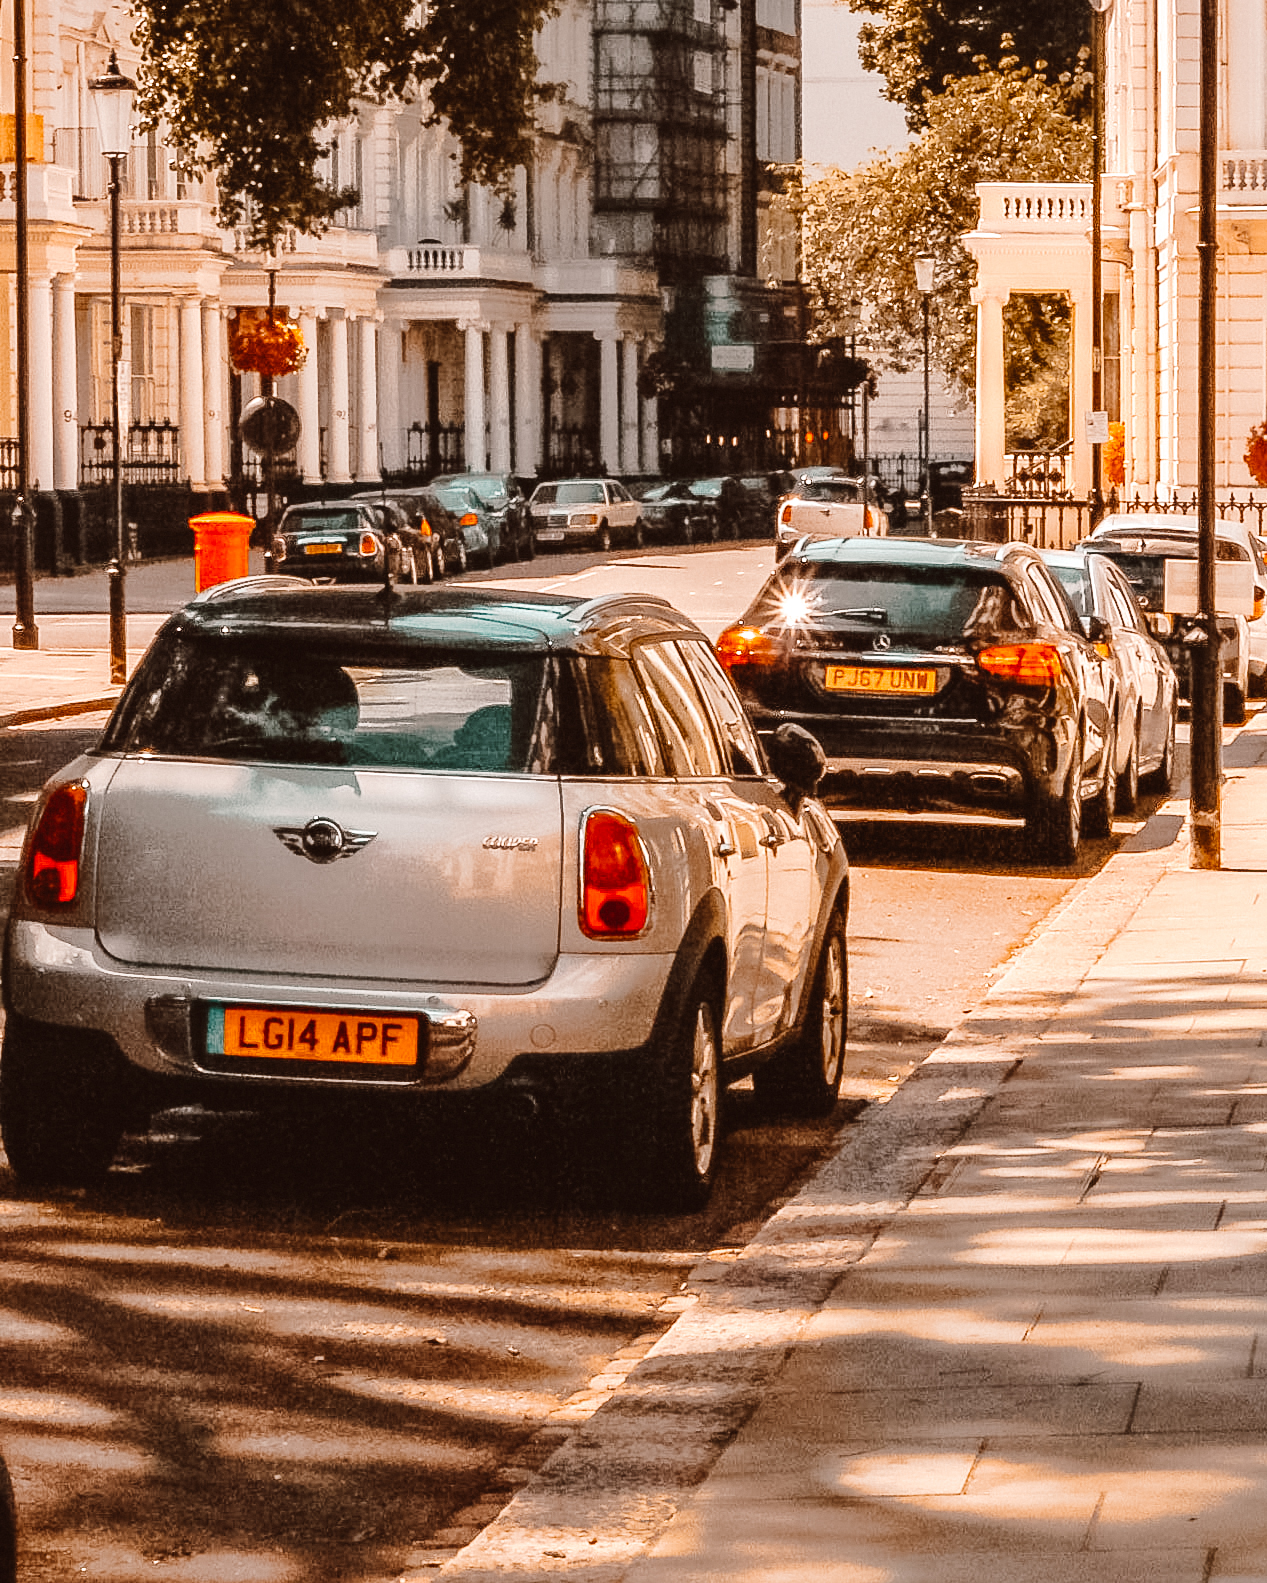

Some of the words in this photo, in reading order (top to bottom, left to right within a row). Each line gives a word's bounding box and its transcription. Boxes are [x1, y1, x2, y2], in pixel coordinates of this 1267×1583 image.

[833, 668, 885, 688] PJ67
[890, 671, 929, 690] UNW
[238, 1015, 319, 1052] LG14
[332, 1020, 404, 1057] APF
